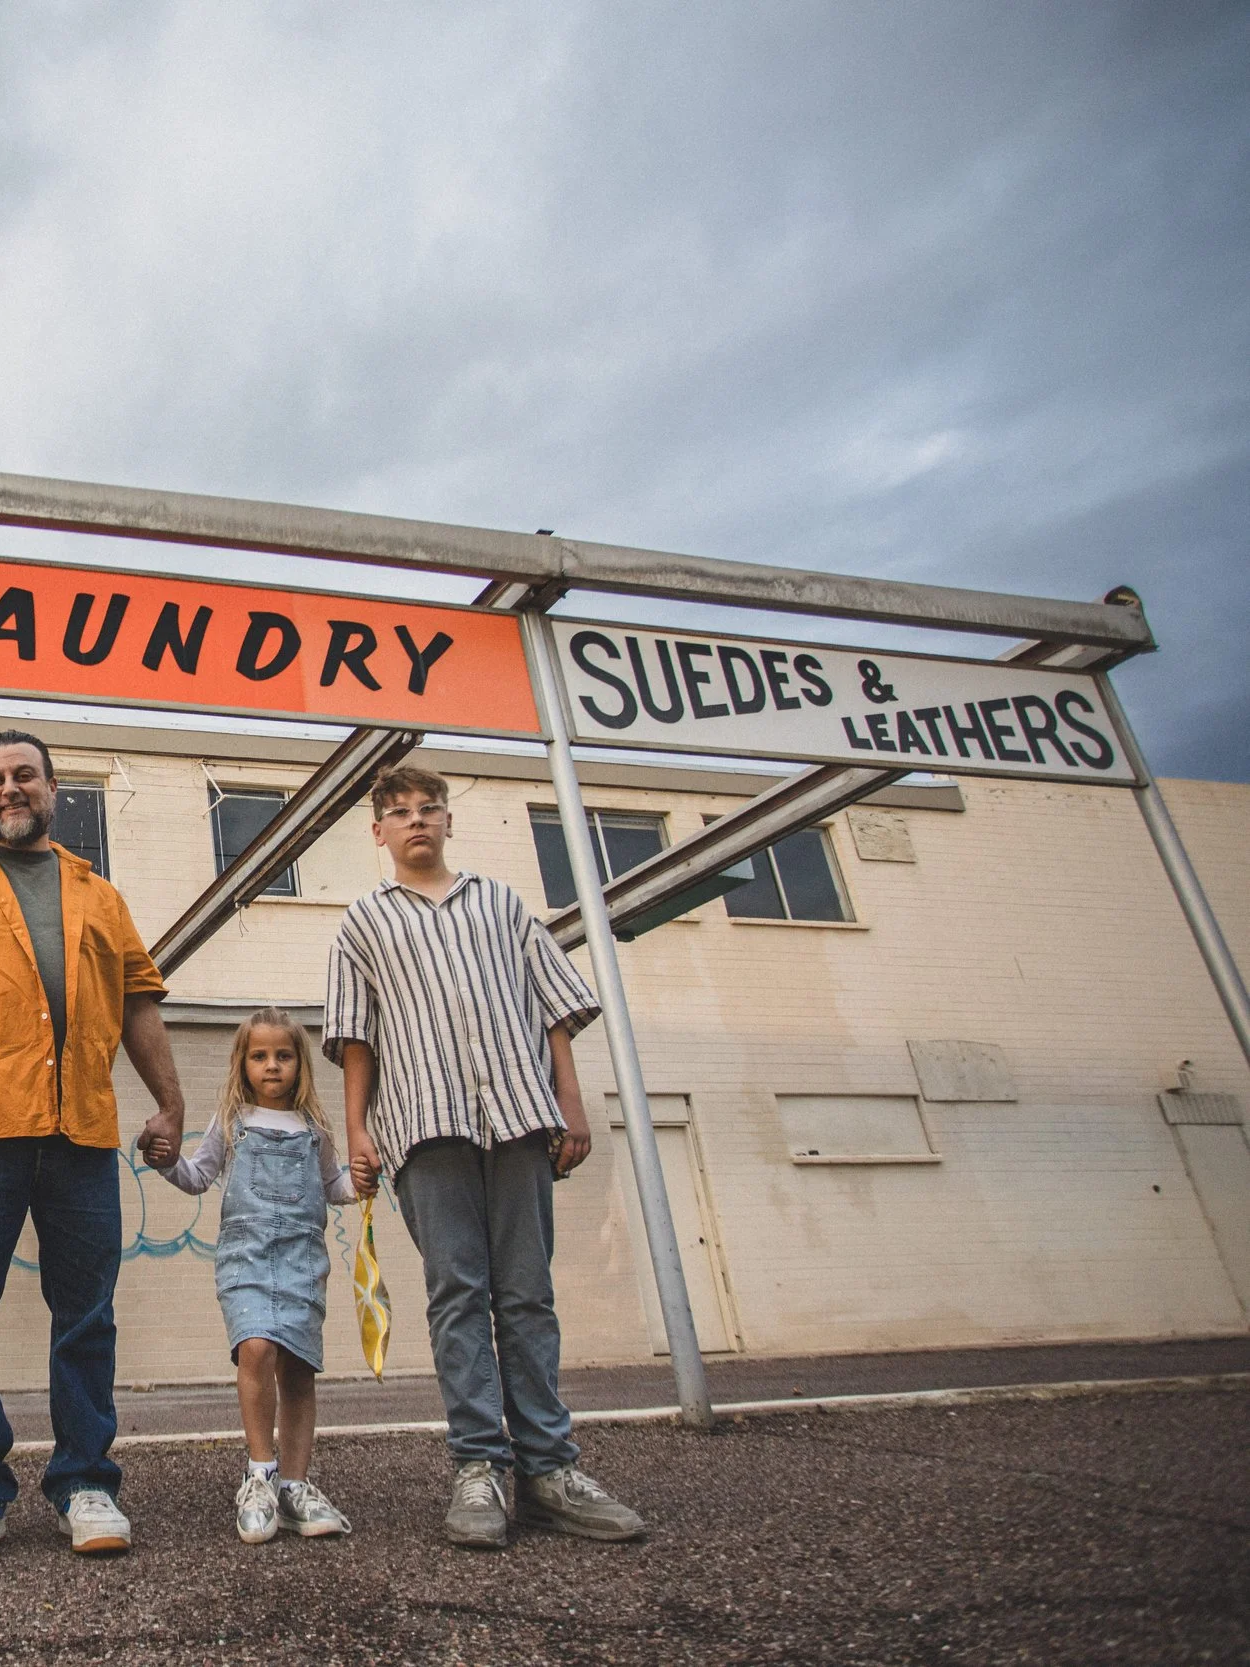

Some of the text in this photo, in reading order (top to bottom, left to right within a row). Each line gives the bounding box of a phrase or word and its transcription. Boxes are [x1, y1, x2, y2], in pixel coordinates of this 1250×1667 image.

[569, 630, 899, 730] SUEDES &
[841, 689, 1115, 771] LEATHERS
